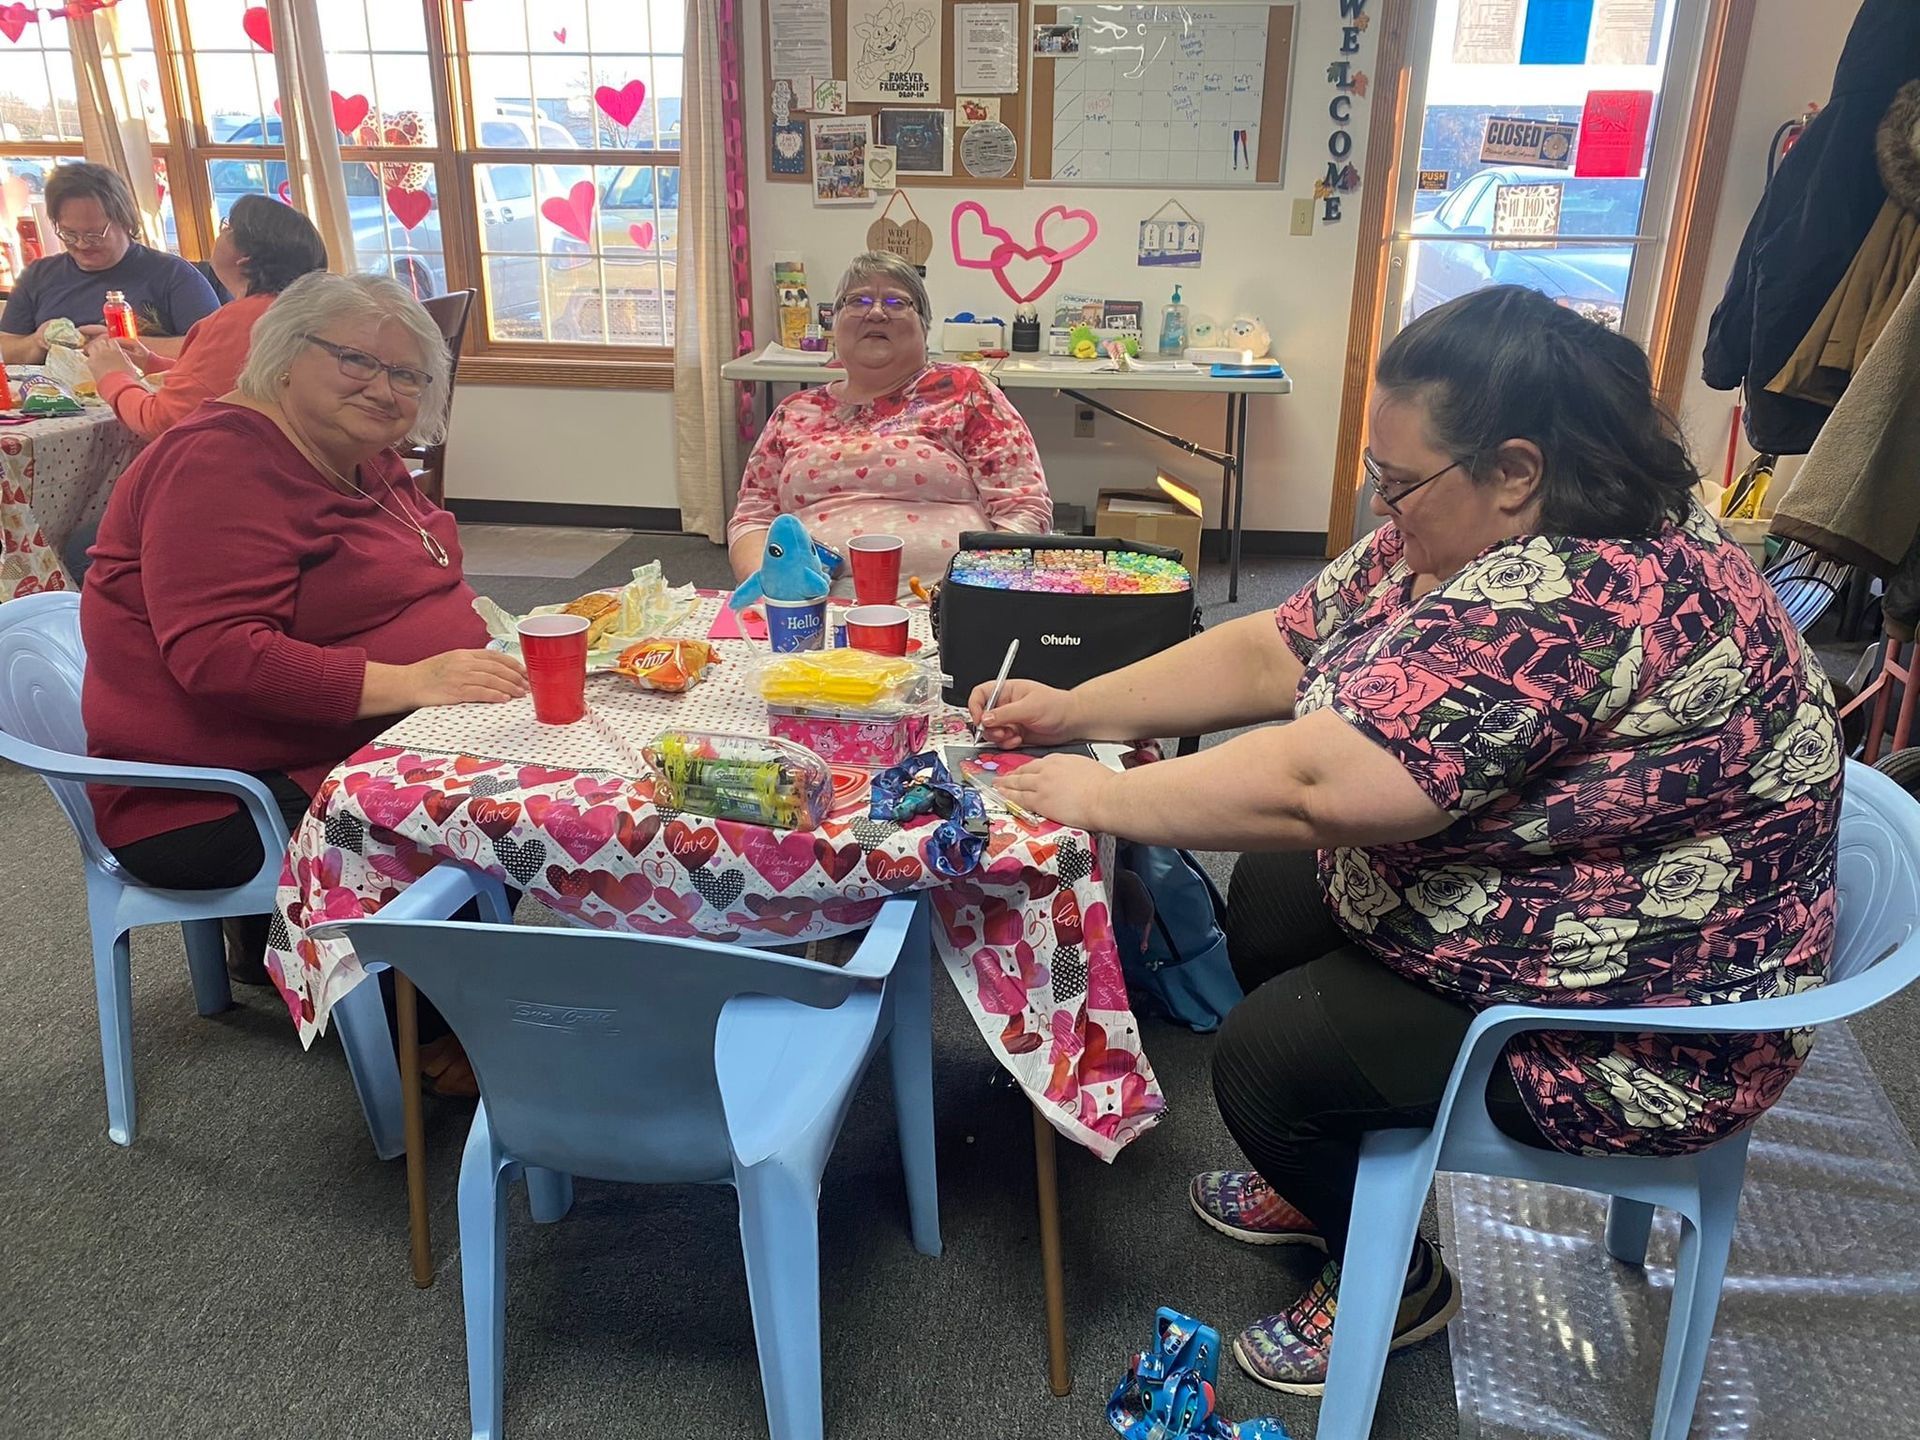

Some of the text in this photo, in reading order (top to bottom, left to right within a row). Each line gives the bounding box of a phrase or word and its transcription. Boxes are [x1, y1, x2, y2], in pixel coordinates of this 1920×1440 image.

[888, 72, 924, 82] FOREVER
[879, 83, 929, 92] FRIENDSHIPS
[1322, 0, 1364, 221] WELCOME
[1487, 122, 1542, 148] CLOSED
[1421, 171, 1446, 181] PUSH
[887, 228, 910, 238] WIFI
[1168, 232, 1174, 243] 1
[1188, 232, 1196, 243] 4
[887, 237, 911, 246] sweet
[887, 245, 909, 255] WIFI
[787, 614, 820, 630] Hello
[1040, 634, 1081, 646] Ohuhu
[475, 804, 521, 824] love
[671, 830, 719, 856] love
[873, 859, 922, 883] love
